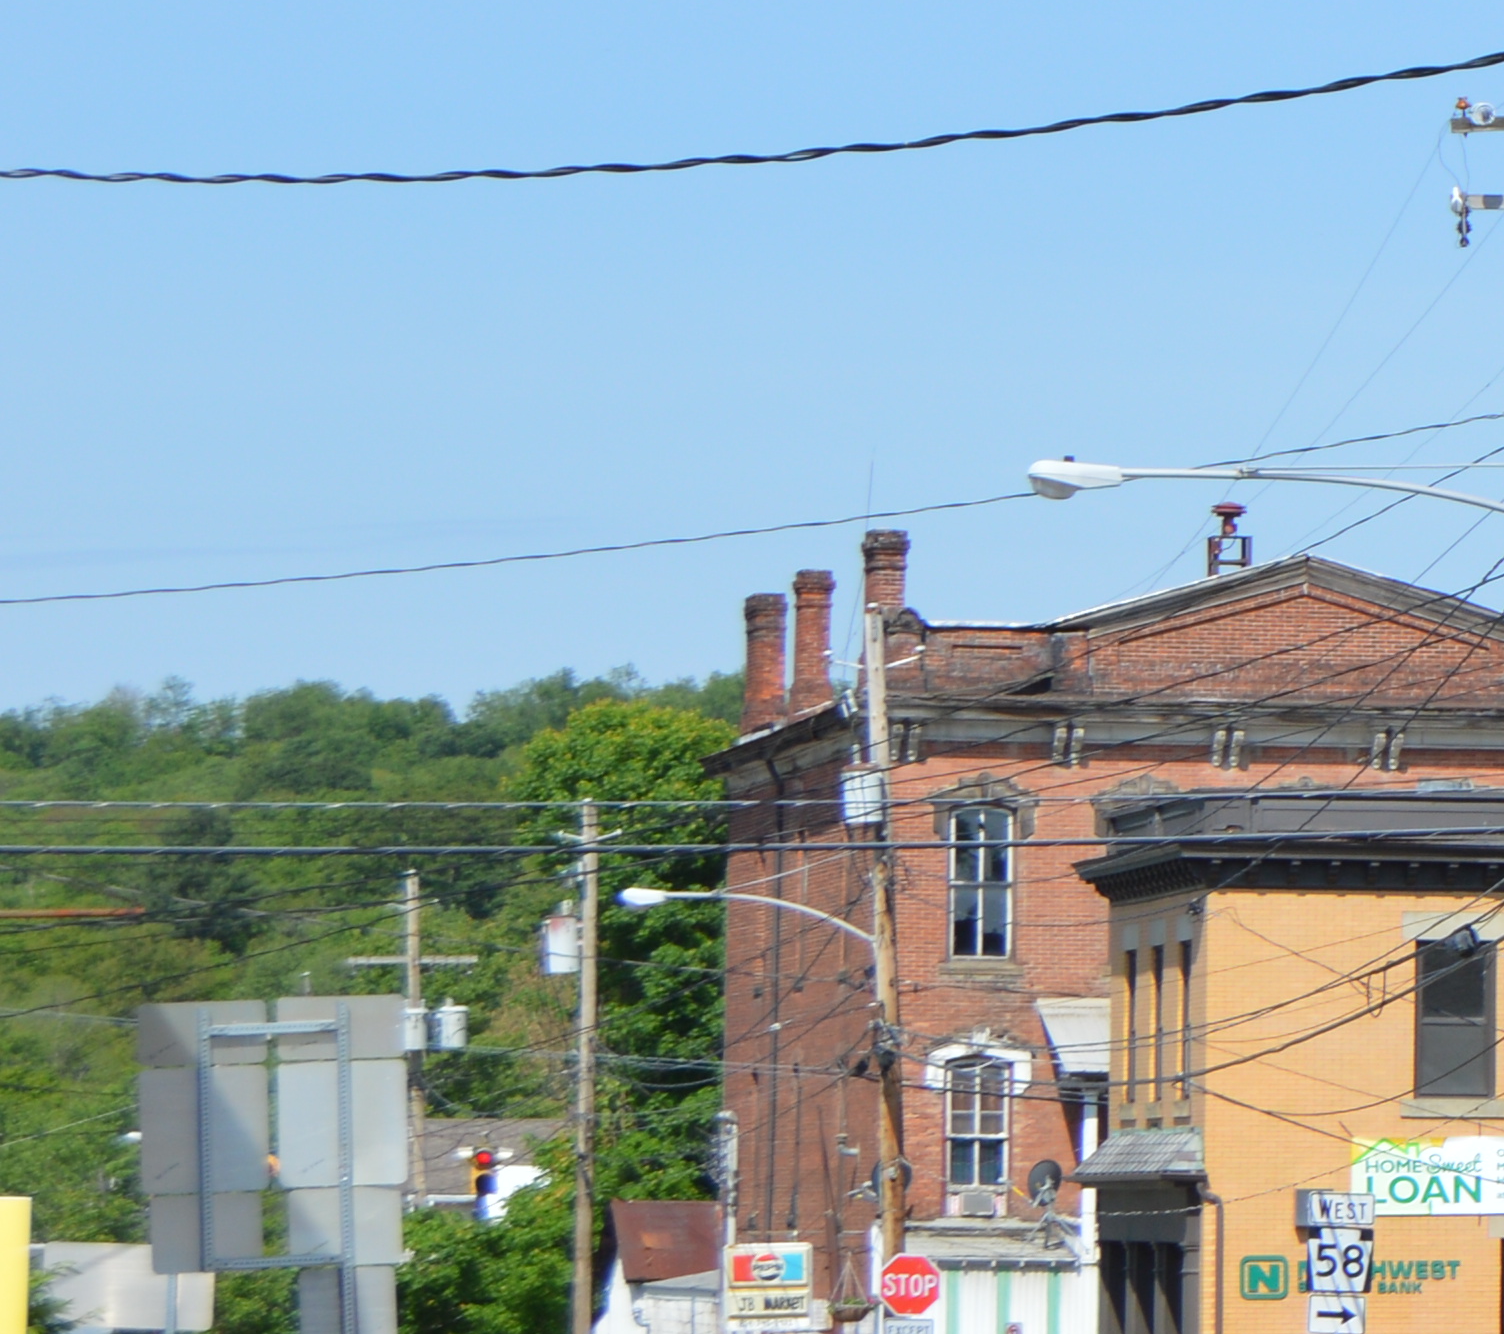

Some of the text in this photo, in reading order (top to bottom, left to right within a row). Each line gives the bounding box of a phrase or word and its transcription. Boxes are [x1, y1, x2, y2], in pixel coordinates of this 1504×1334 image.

[1365, 1153, 1482, 1174] HOME Sweet
[1367, 1175, 1481, 1204] LOAN
[1319, 1198, 1367, 1220] WEST
[1316, 1244, 1364, 1278] 58
[883, 1273, 938, 1297] STOP
[1249, 1263, 1280, 1292] N
[1377, 1282, 1423, 1294] BANK
[764, 1295, 805, 1311] MARKET
